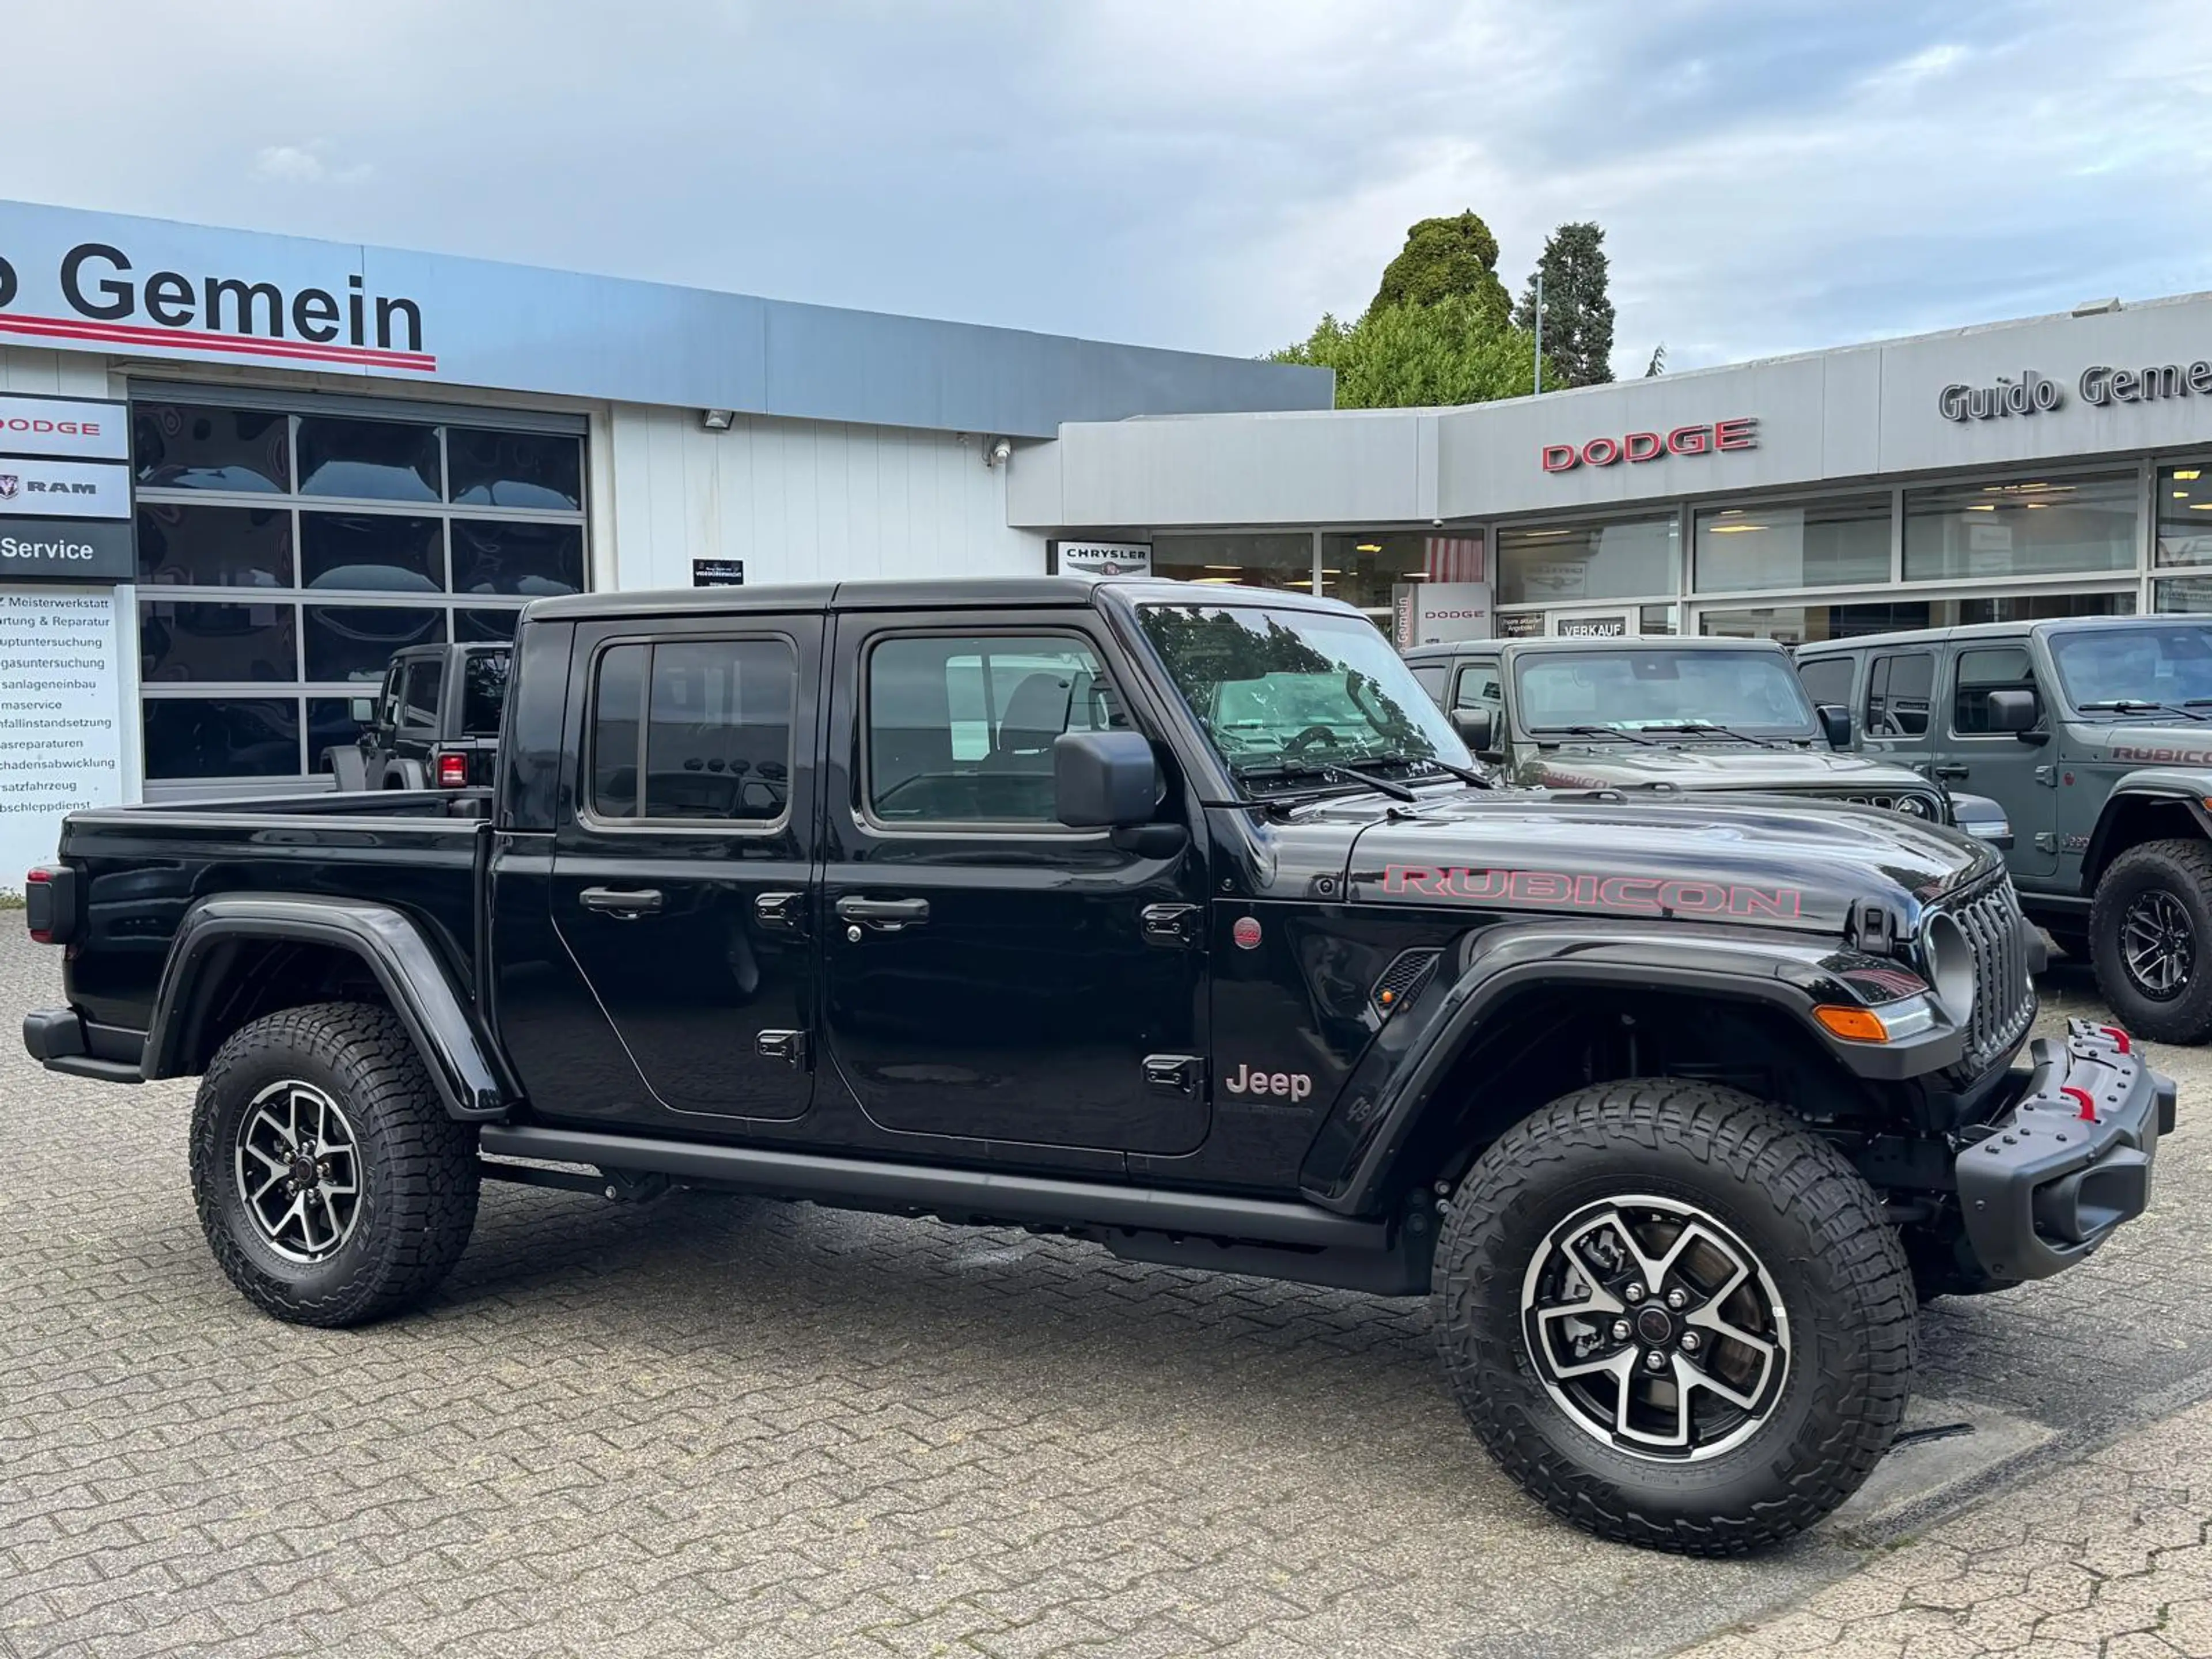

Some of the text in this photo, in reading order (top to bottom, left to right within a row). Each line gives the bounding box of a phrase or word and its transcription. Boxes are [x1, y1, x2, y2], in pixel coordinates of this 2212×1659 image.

[60, 243, 422, 351] Gemein
[1938, 370, 2061, 421] Guido
[0, 418, 100, 436] ODGE
[1542, 417, 1757, 473] DODGE
[27, 481, 96, 495] RAM
[1, 537, 94, 560] Service
[1067, 548, 1146, 559] CHRYSLER
[9, 597, 109, 608] Meisterwerkstatt
[1425, 610, 1486, 619] DODGE
[40, 616, 48, 626] &
[52, 616, 111, 628] Reparatur
[1565, 624, 1622, 637] VERKAUF
[1, 657, 105, 671] gasuntersuchung
[2, 679, 96, 691] sanlageneinbau
[1, 700, 63, 710] maservice
[0, 781, 77, 791] satzfahrzeug
[1382, 863, 1801, 918] RUBICON
[1225, 1064, 1312, 1103] Jeep
